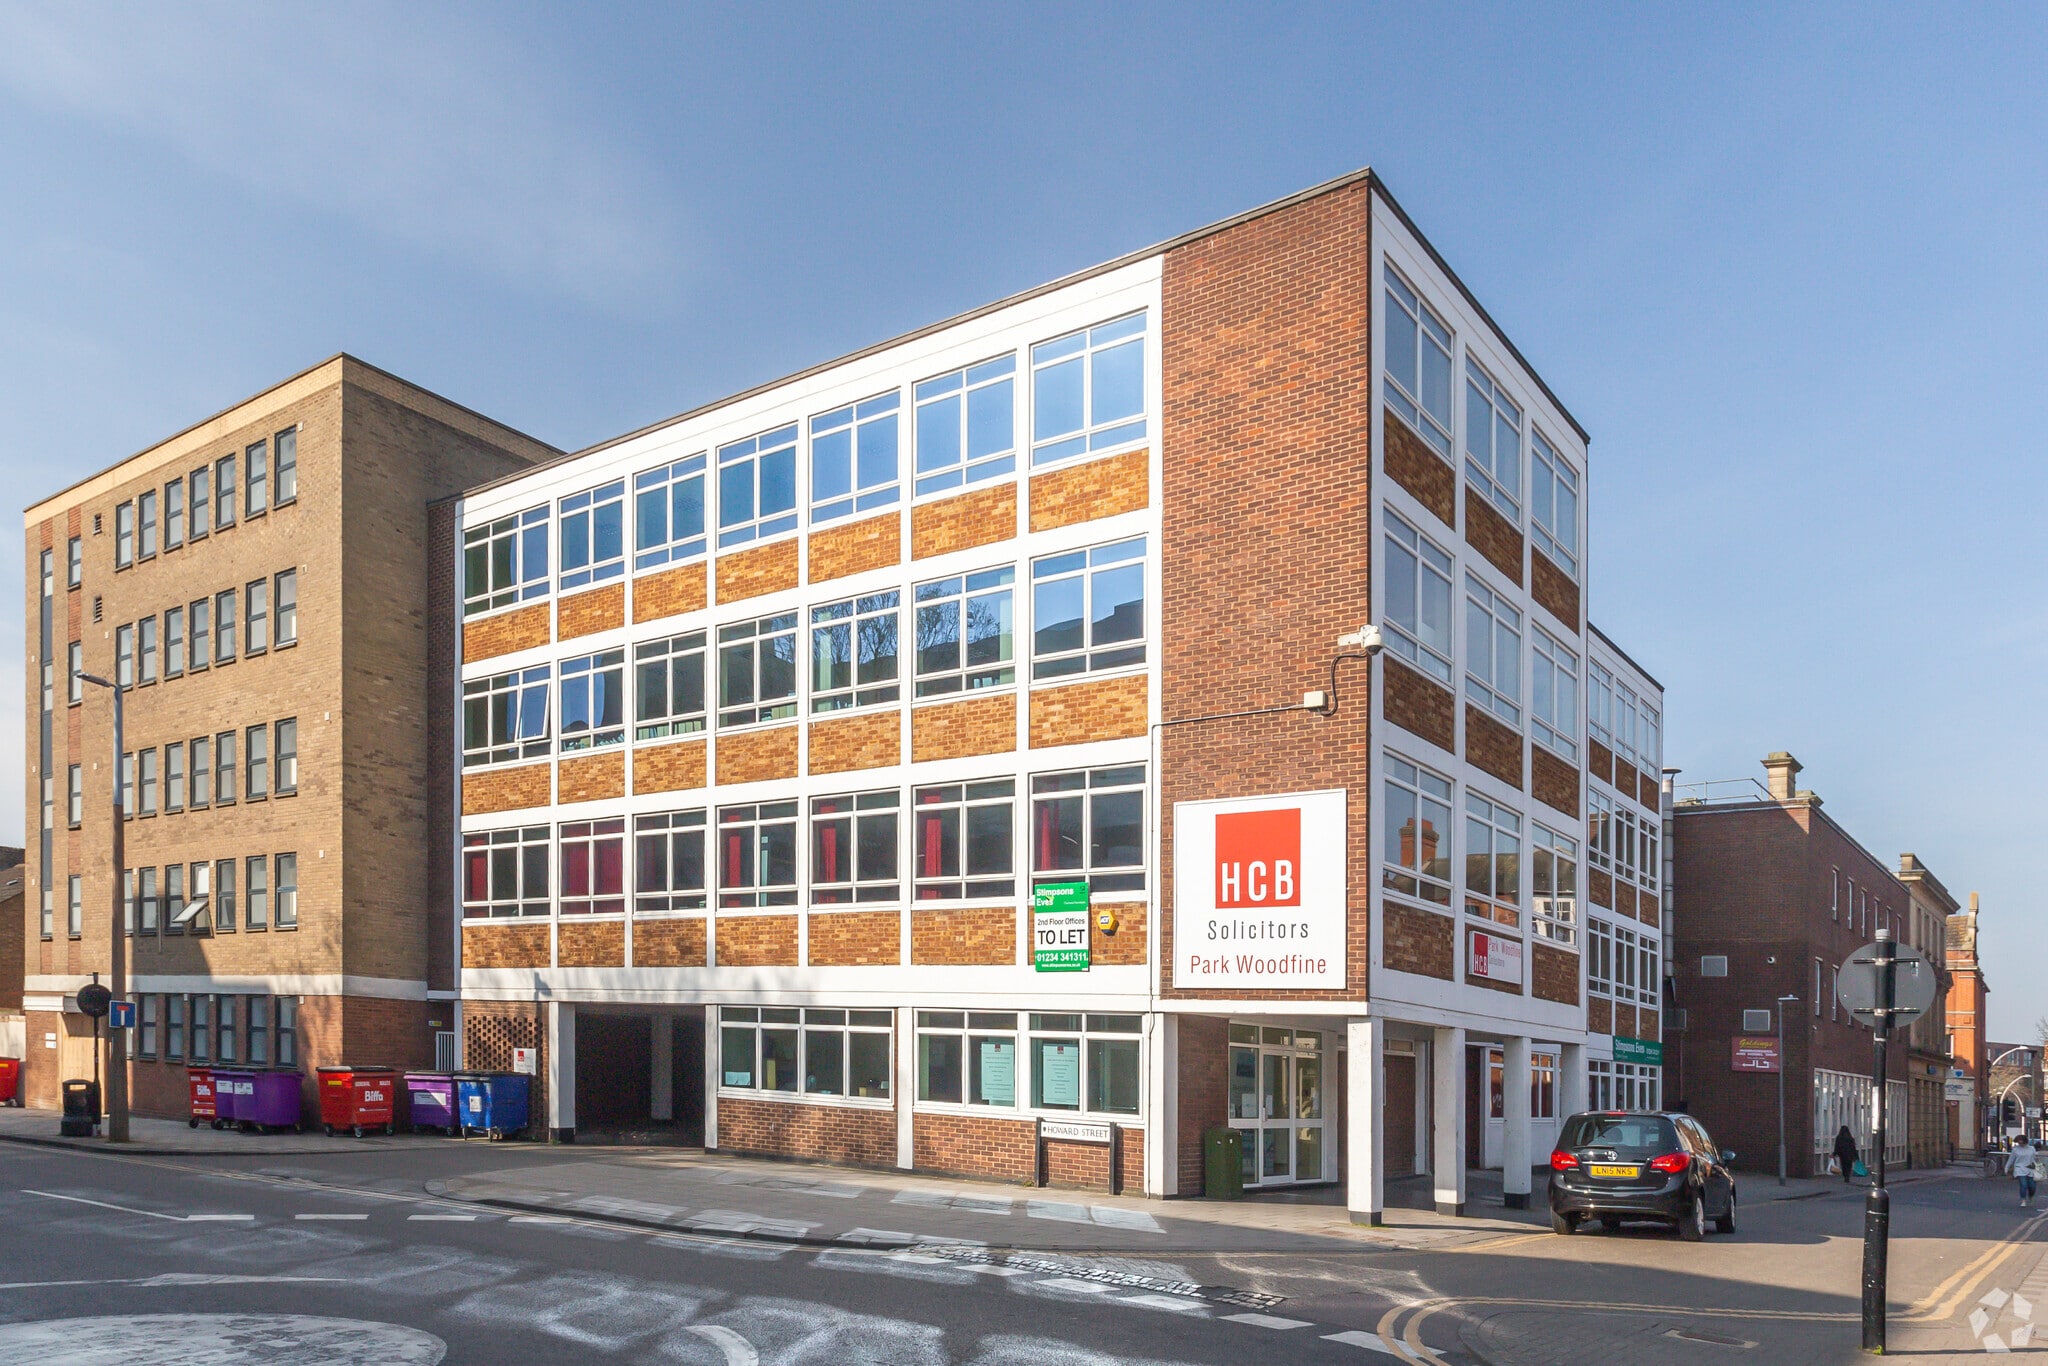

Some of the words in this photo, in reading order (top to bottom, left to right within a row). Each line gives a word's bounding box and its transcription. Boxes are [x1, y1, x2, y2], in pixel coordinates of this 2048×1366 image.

[1221, 859, 1294, 902] HCB
[1036, 888, 1074, 897] Stimpsons
[1065, 917, 1085, 925] Offices
[1207, 919, 1309, 940] Solicitors
[1037, 930, 1056, 945] TO
[1060, 929, 1086, 944] LET
[1036, 953, 1058, 962] 01234
[1060, 952, 1087, 961] 341311
[1474, 954, 1488, 973] HCB
[1191, 955, 1229, 974] Park
[1236, 955, 1326, 974] Woodfine
[364, 1090, 384, 1102] Biffa
[1047, 1126, 1079, 1136] HOWARD
[1081, 1128, 1109, 1138] STREET
